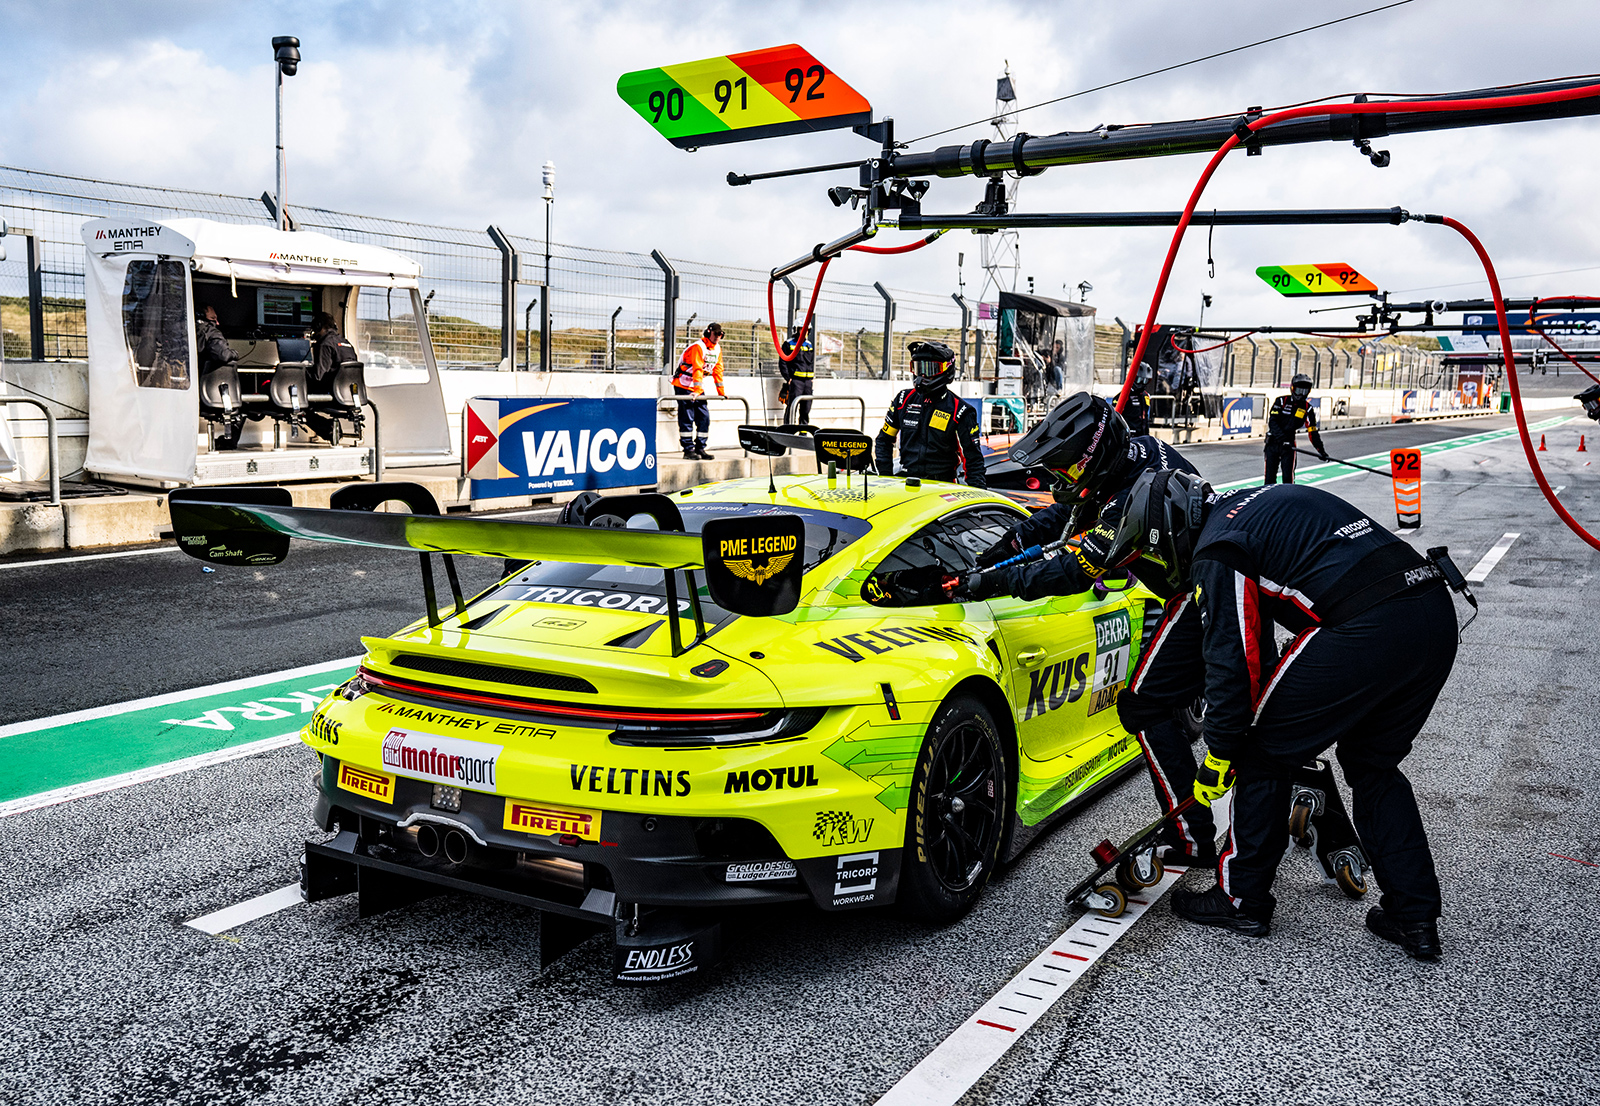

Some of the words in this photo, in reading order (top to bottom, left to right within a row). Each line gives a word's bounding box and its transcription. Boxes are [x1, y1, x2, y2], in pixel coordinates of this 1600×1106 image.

[648, 87, 684, 124] 90
[714, 76, 748, 114] 91
[785, 65, 825, 103] 92
[108, 226, 162, 239] MANTHEY
[114, 240, 143, 251] EMA
[280, 253, 329, 264] MANTHEY
[1272, 274, 1291, 288] 90
[1305, 272, 1322, 286] 91
[1339, 271, 1359, 285] 92
[933, 410, 950, 421] ADAC
[471, 434, 488, 443] ABT
[822, 440, 838, 448] PME
[839, 441, 868, 449] LEGEND
[1393, 453, 1419, 470] 92
[528, 481, 547, 490] Powered
[1333, 518, 1370, 538] TRICORP
[720, 538, 748, 558] PME
[751, 534, 797, 554] LEGEND
[517, 586, 691, 616] TRICORP
[1096, 615, 1130, 648] DEKRA
[812, 626, 981, 663] VELTINS
[1103, 650, 1120, 686] 91
[1024, 652, 1090, 721] KÜS
[1094, 685, 1118, 712] ADAC
[392, 707, 489, 730] MANTHEY
[493, 723, 557, 740] EMA
[383, 731, 403, 749] Auto
[384, 748, 400, 767] Bild
[341, 765, 390, 797] PIRELLI
[569, 764, 692, 797] VELTINS
[723, 764, 819, 794] MOTUL
[916, 745, 934, 863] PIRELLI
[511, 803, 593, 836] PIRELLI
[822, 818, 874, 847] KW
[736, 871, 767, 881] Ludger
[768, 869, 796, 878] Ferner
[836, 867, 878, 880] TRICORP
[833, 893, 875, 906] WORKWEAR
[625, 941, 694, 969] ENDLESS
[617, 974, 642, 982] Advanced
[661, 972, 675, 980] Brake
[675, 965, 699, 977] Technology
